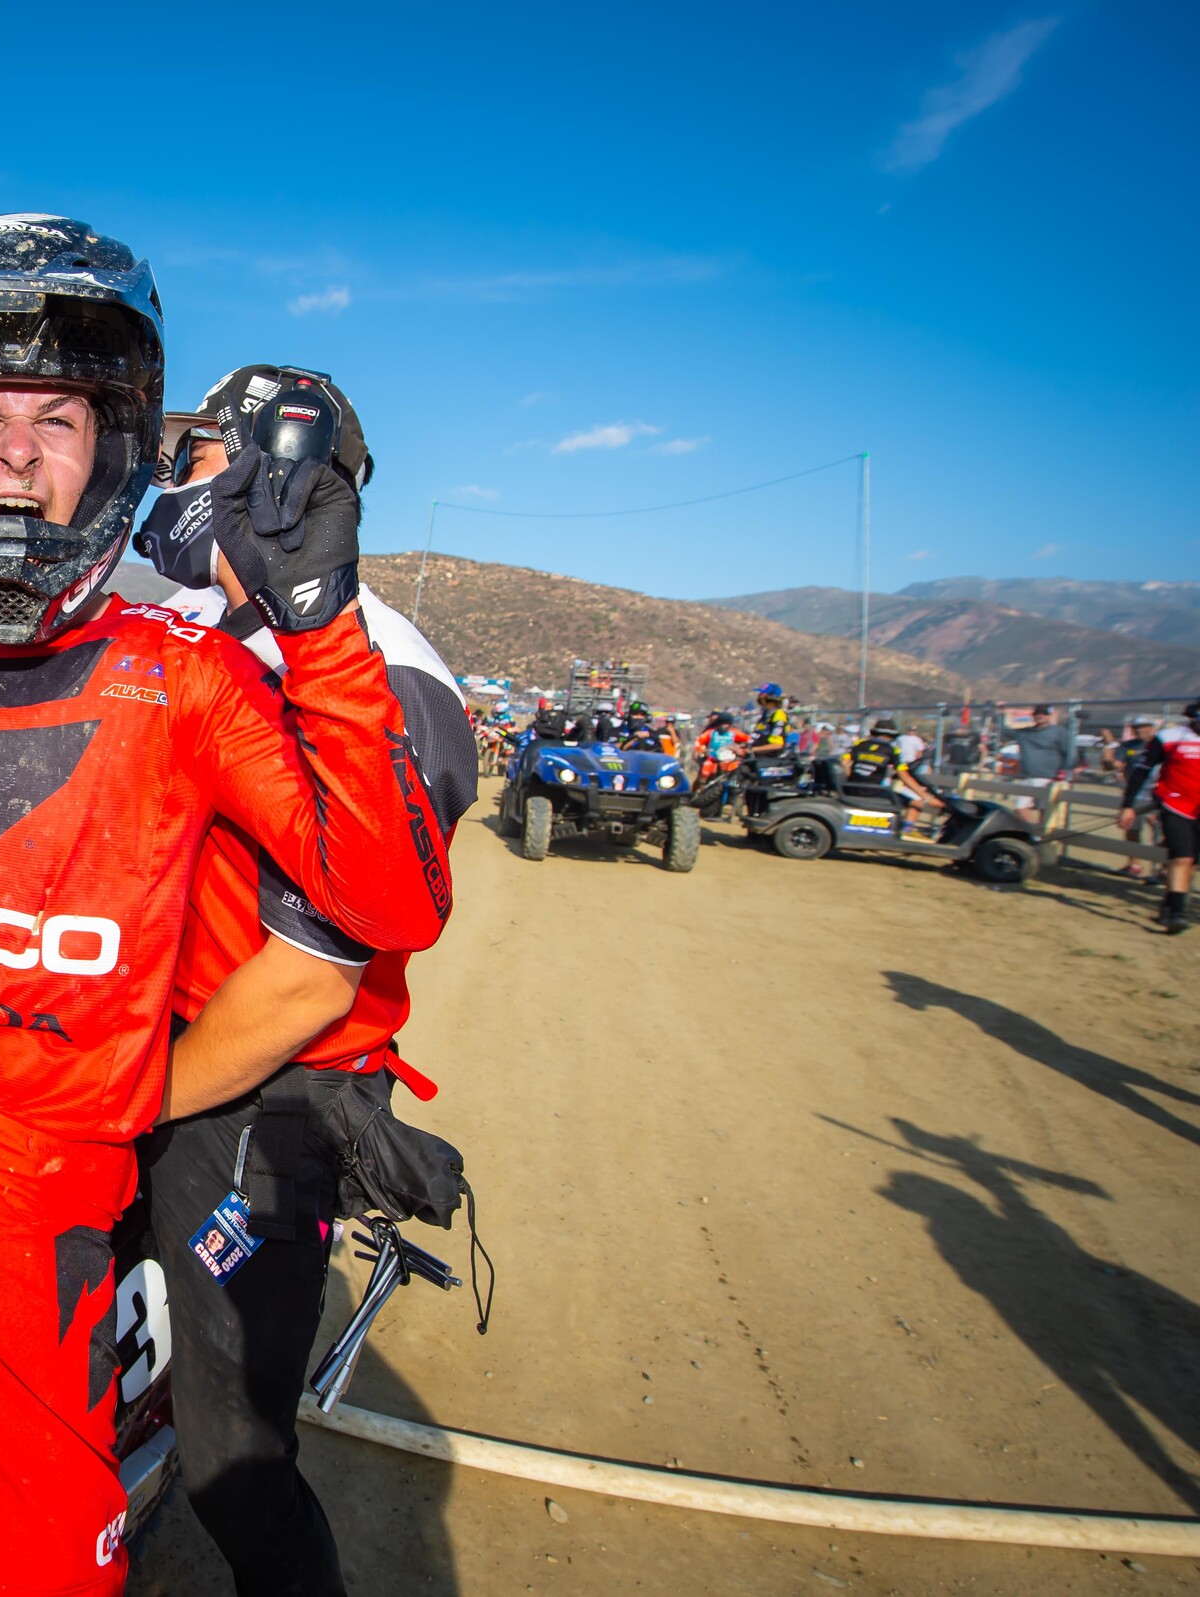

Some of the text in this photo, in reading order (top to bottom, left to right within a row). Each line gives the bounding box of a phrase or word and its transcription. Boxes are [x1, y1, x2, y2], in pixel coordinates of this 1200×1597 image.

[284, 406, 317, 417] GEICO
[169, 489, 212, 541] GEICO
[120, 604, 207, 643] GEIO
[426, 860, 452, 910] CBD
[222, 1208, 256, 1247] MOTOCROSS
[194, 1242, 223, 1277] CREW
[221, 1246, 244, 1272] 2020
